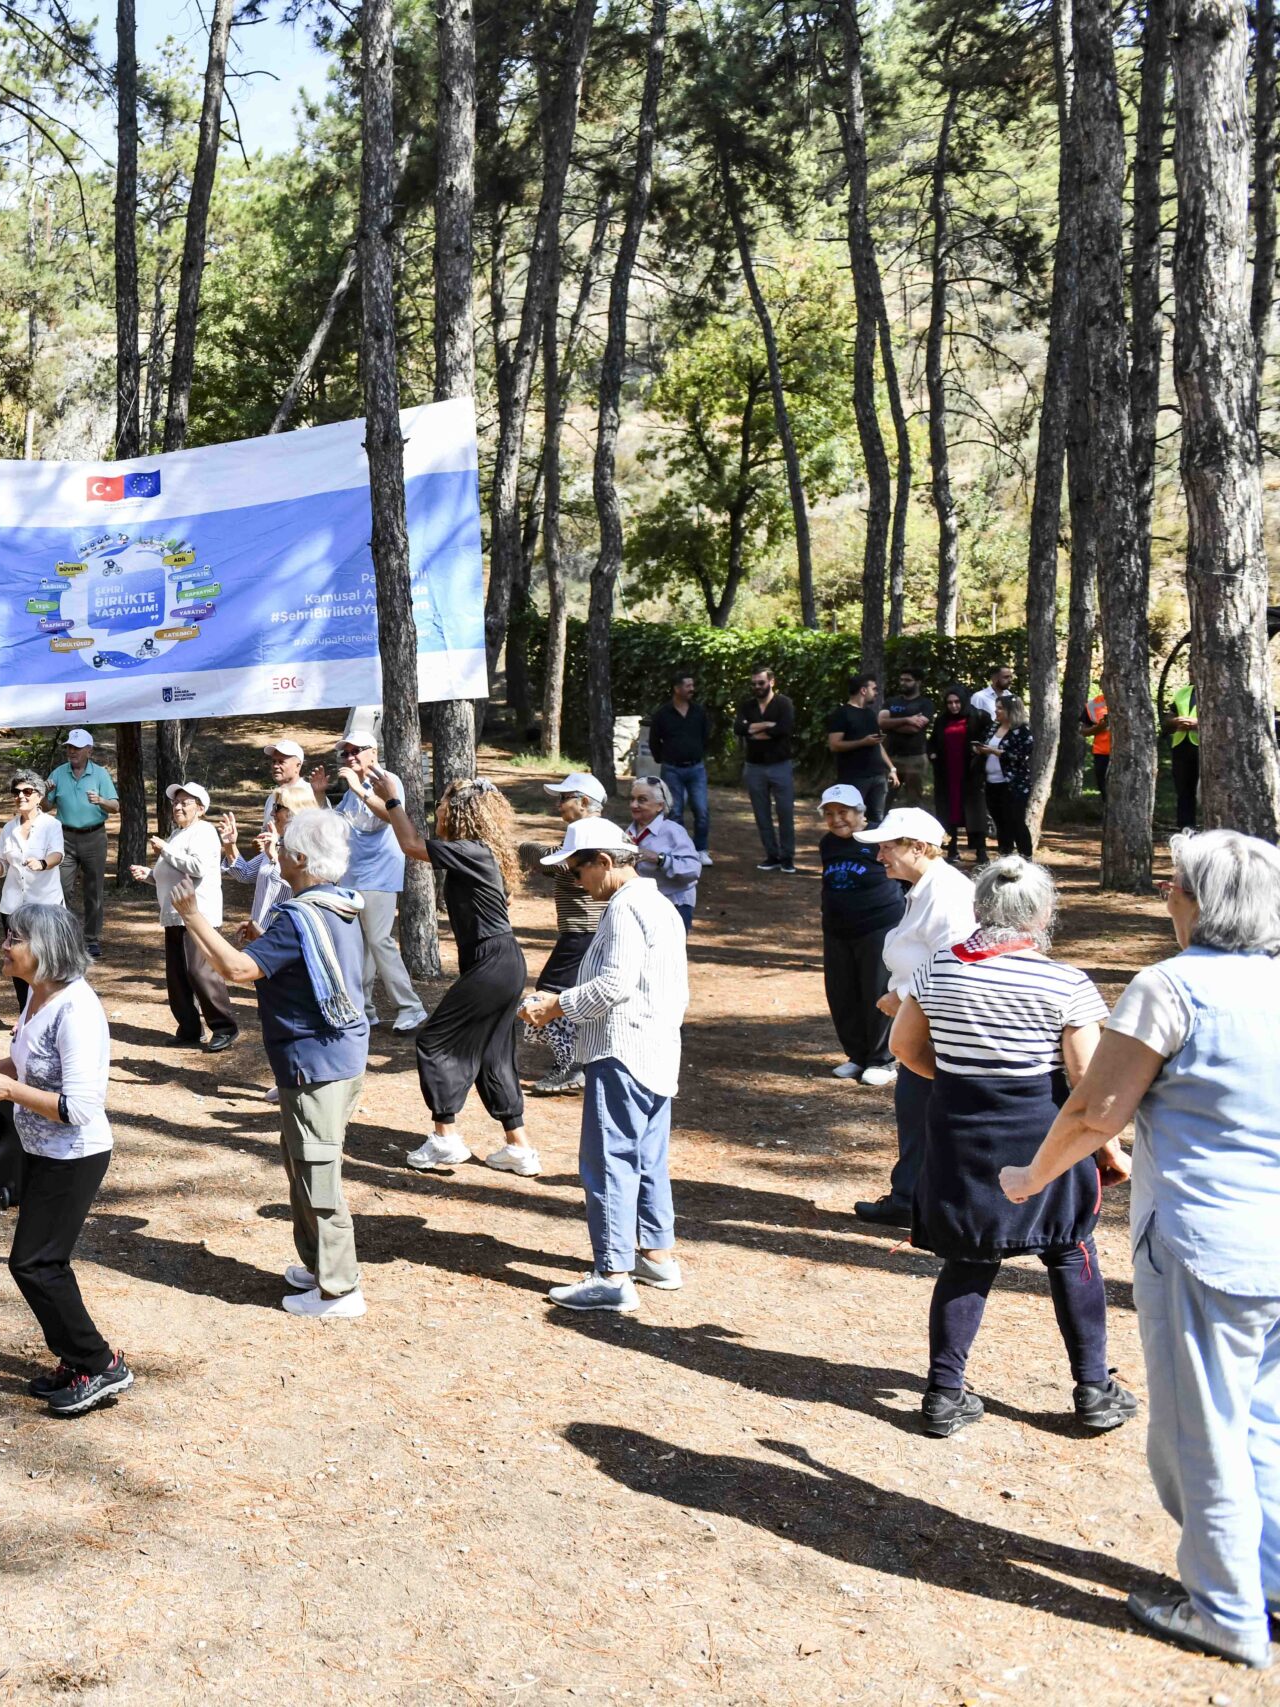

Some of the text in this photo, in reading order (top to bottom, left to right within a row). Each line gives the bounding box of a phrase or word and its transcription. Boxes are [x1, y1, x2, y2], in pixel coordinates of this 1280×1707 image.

[95, 584, 124, 597] ŞEHRİ
[304, 589, 360, 605] Kamusal
[95, 592, 156, 608] BİRLİKTE
[95, 603, 159, 619] YAŞAYALIM!
